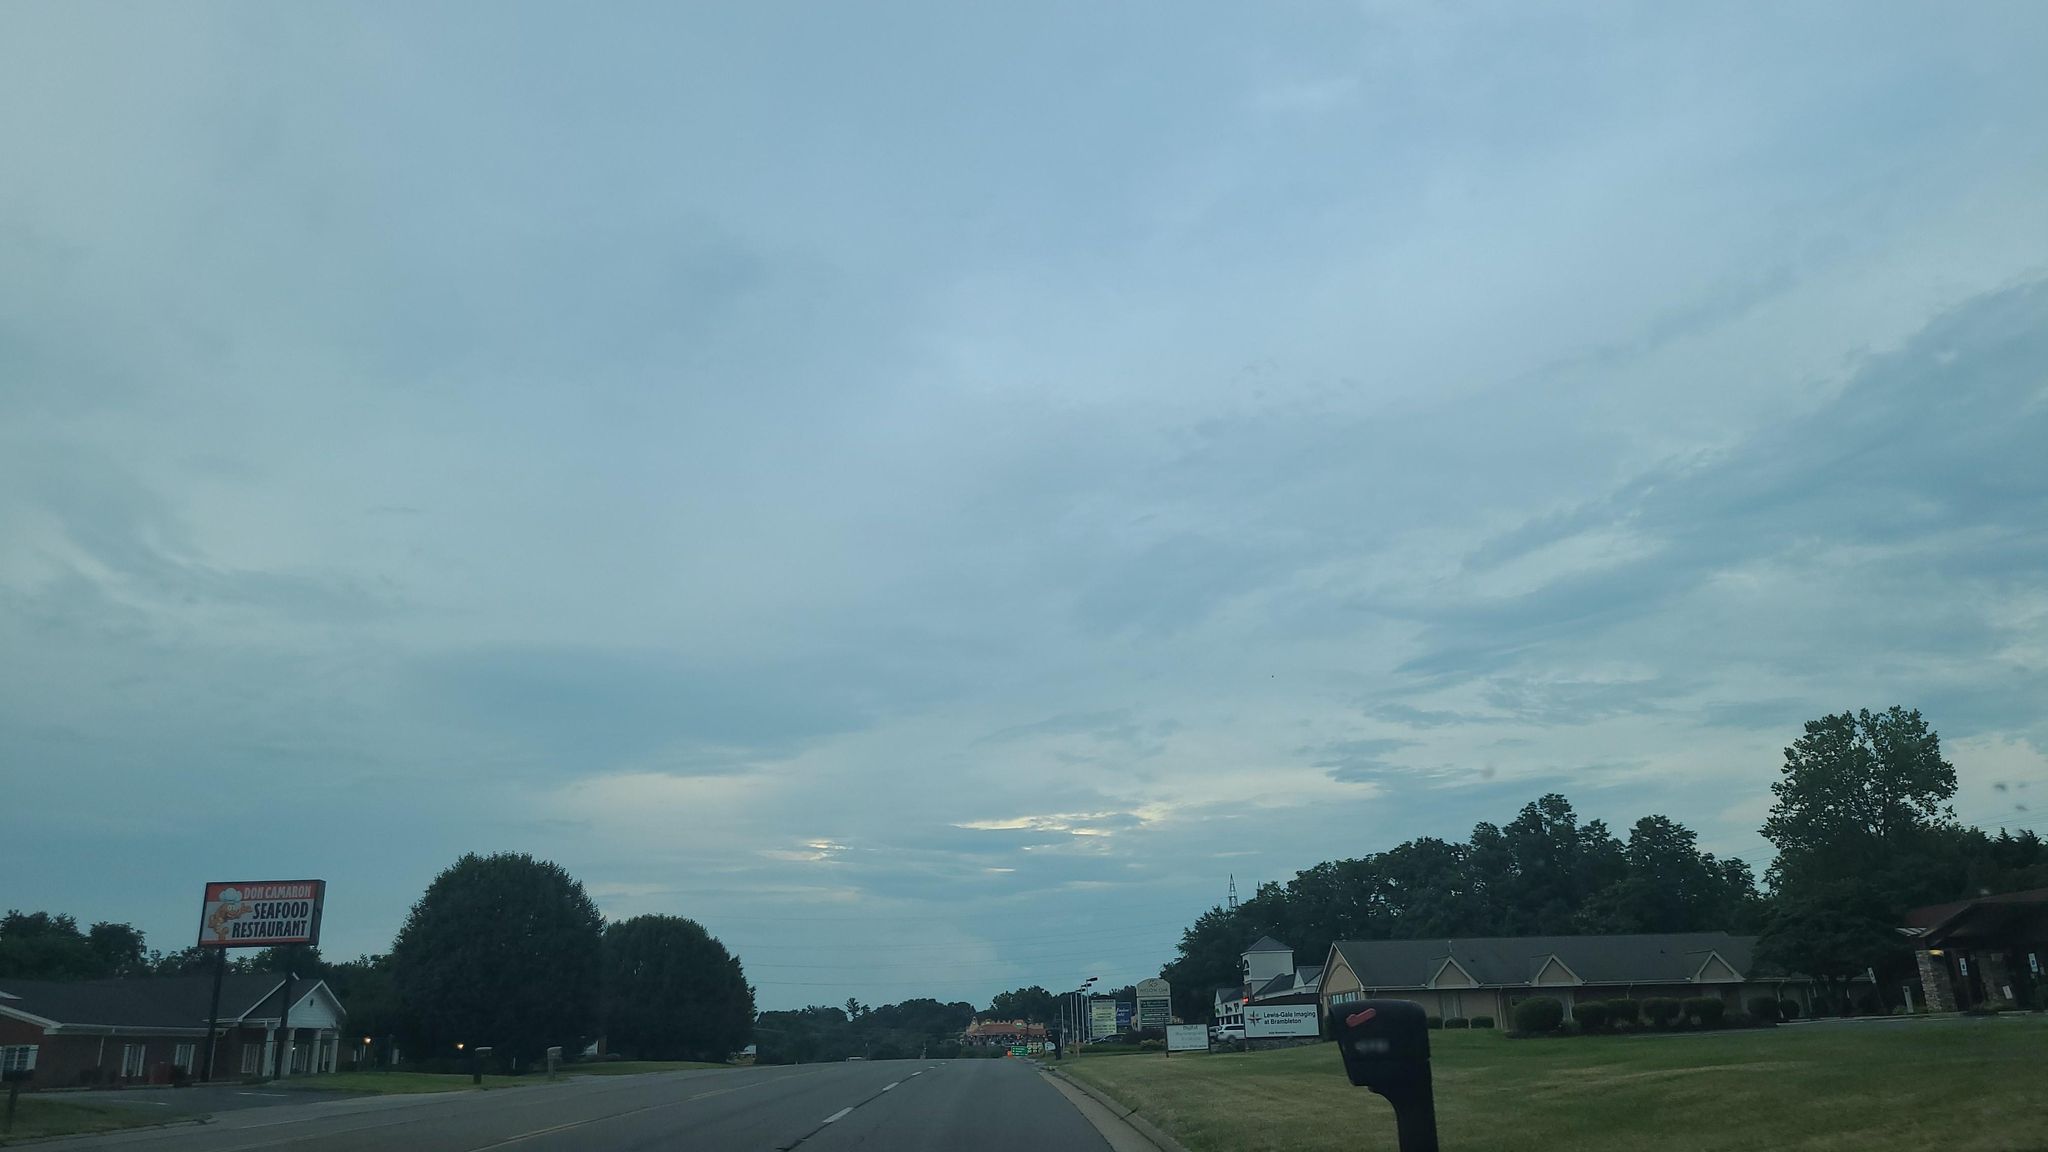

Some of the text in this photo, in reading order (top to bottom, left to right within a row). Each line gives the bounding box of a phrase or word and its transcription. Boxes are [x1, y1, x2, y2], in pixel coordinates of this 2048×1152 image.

[244, 886, 311, 899] DON CAMARON
[253, 902, 308, 919] SEAFOOD
[232, 921, 307, 938] RESTAURANT
